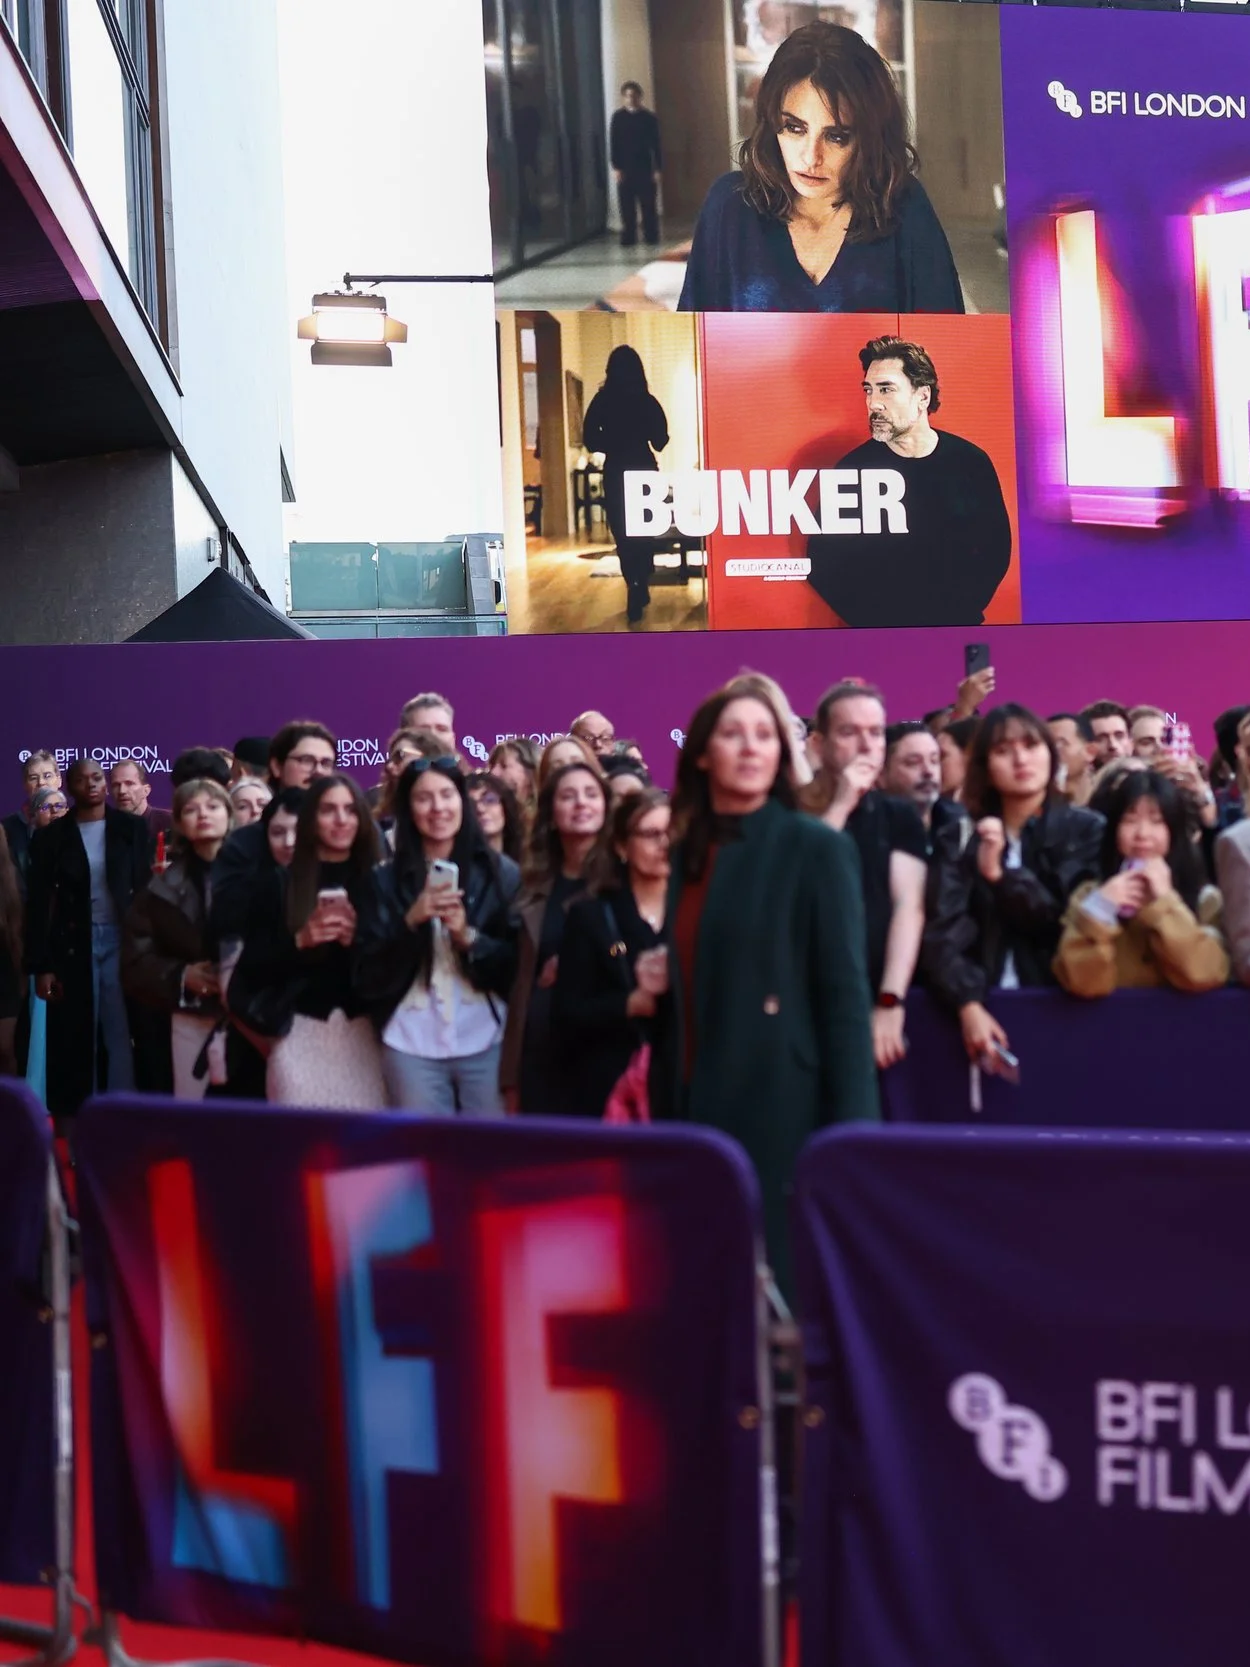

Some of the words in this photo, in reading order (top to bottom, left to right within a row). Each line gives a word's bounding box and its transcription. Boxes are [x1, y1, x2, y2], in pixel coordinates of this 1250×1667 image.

[1090, 90, 1127, 115] BFI
[1134, 92, 1246, 119] LONDON
[623, 468, 909, 537] BUNKER
[730, 562, 805, 573] STUDIOCANAL
[149, 1157, 630, 1635] LFF
[1095, 1379, 1197, 1446] BFI
